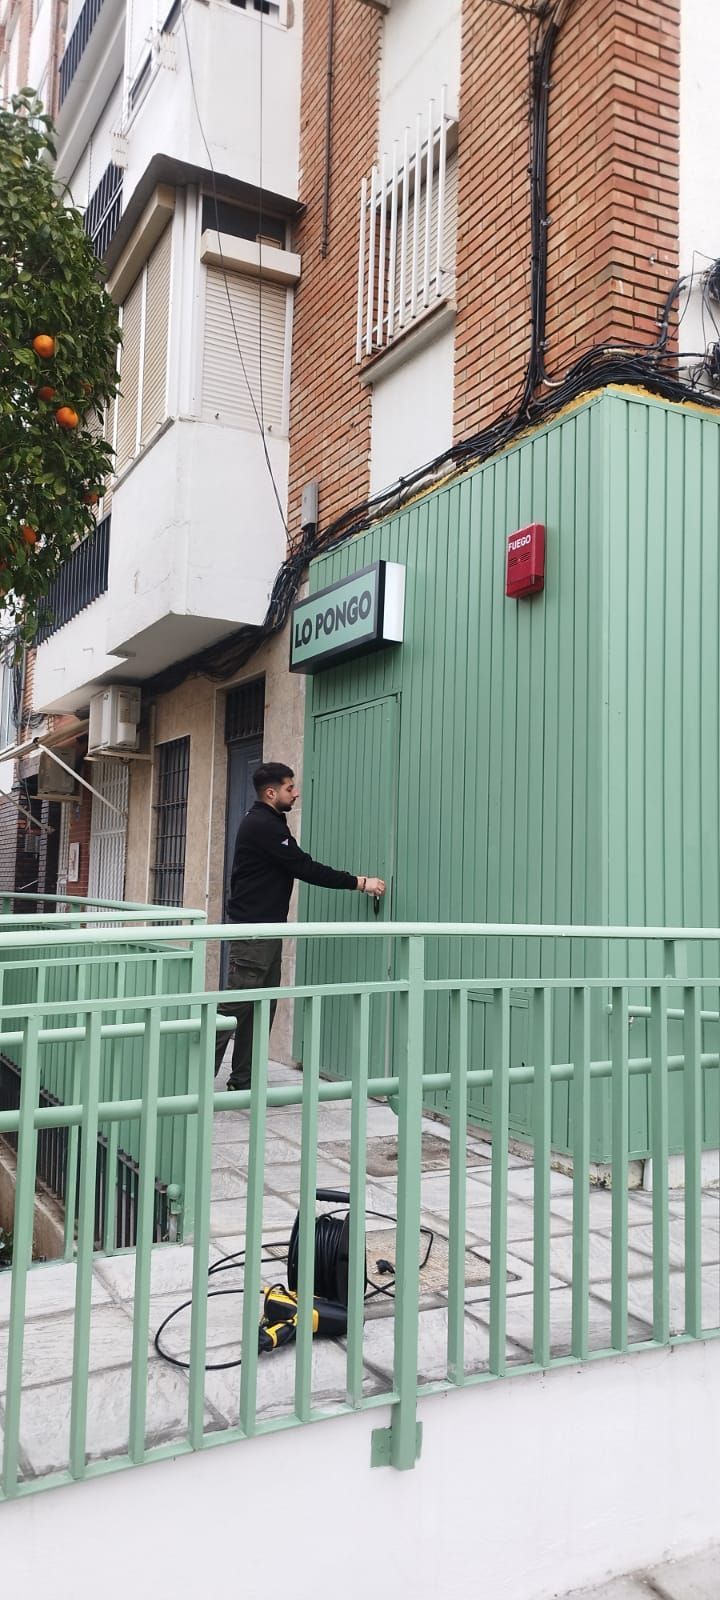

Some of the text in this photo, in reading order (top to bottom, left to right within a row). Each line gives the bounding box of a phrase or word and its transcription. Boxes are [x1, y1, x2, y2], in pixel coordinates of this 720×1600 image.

[508, 534, 532, 553] FUEGO
[294, 590, 372, 649] LO PONGO
